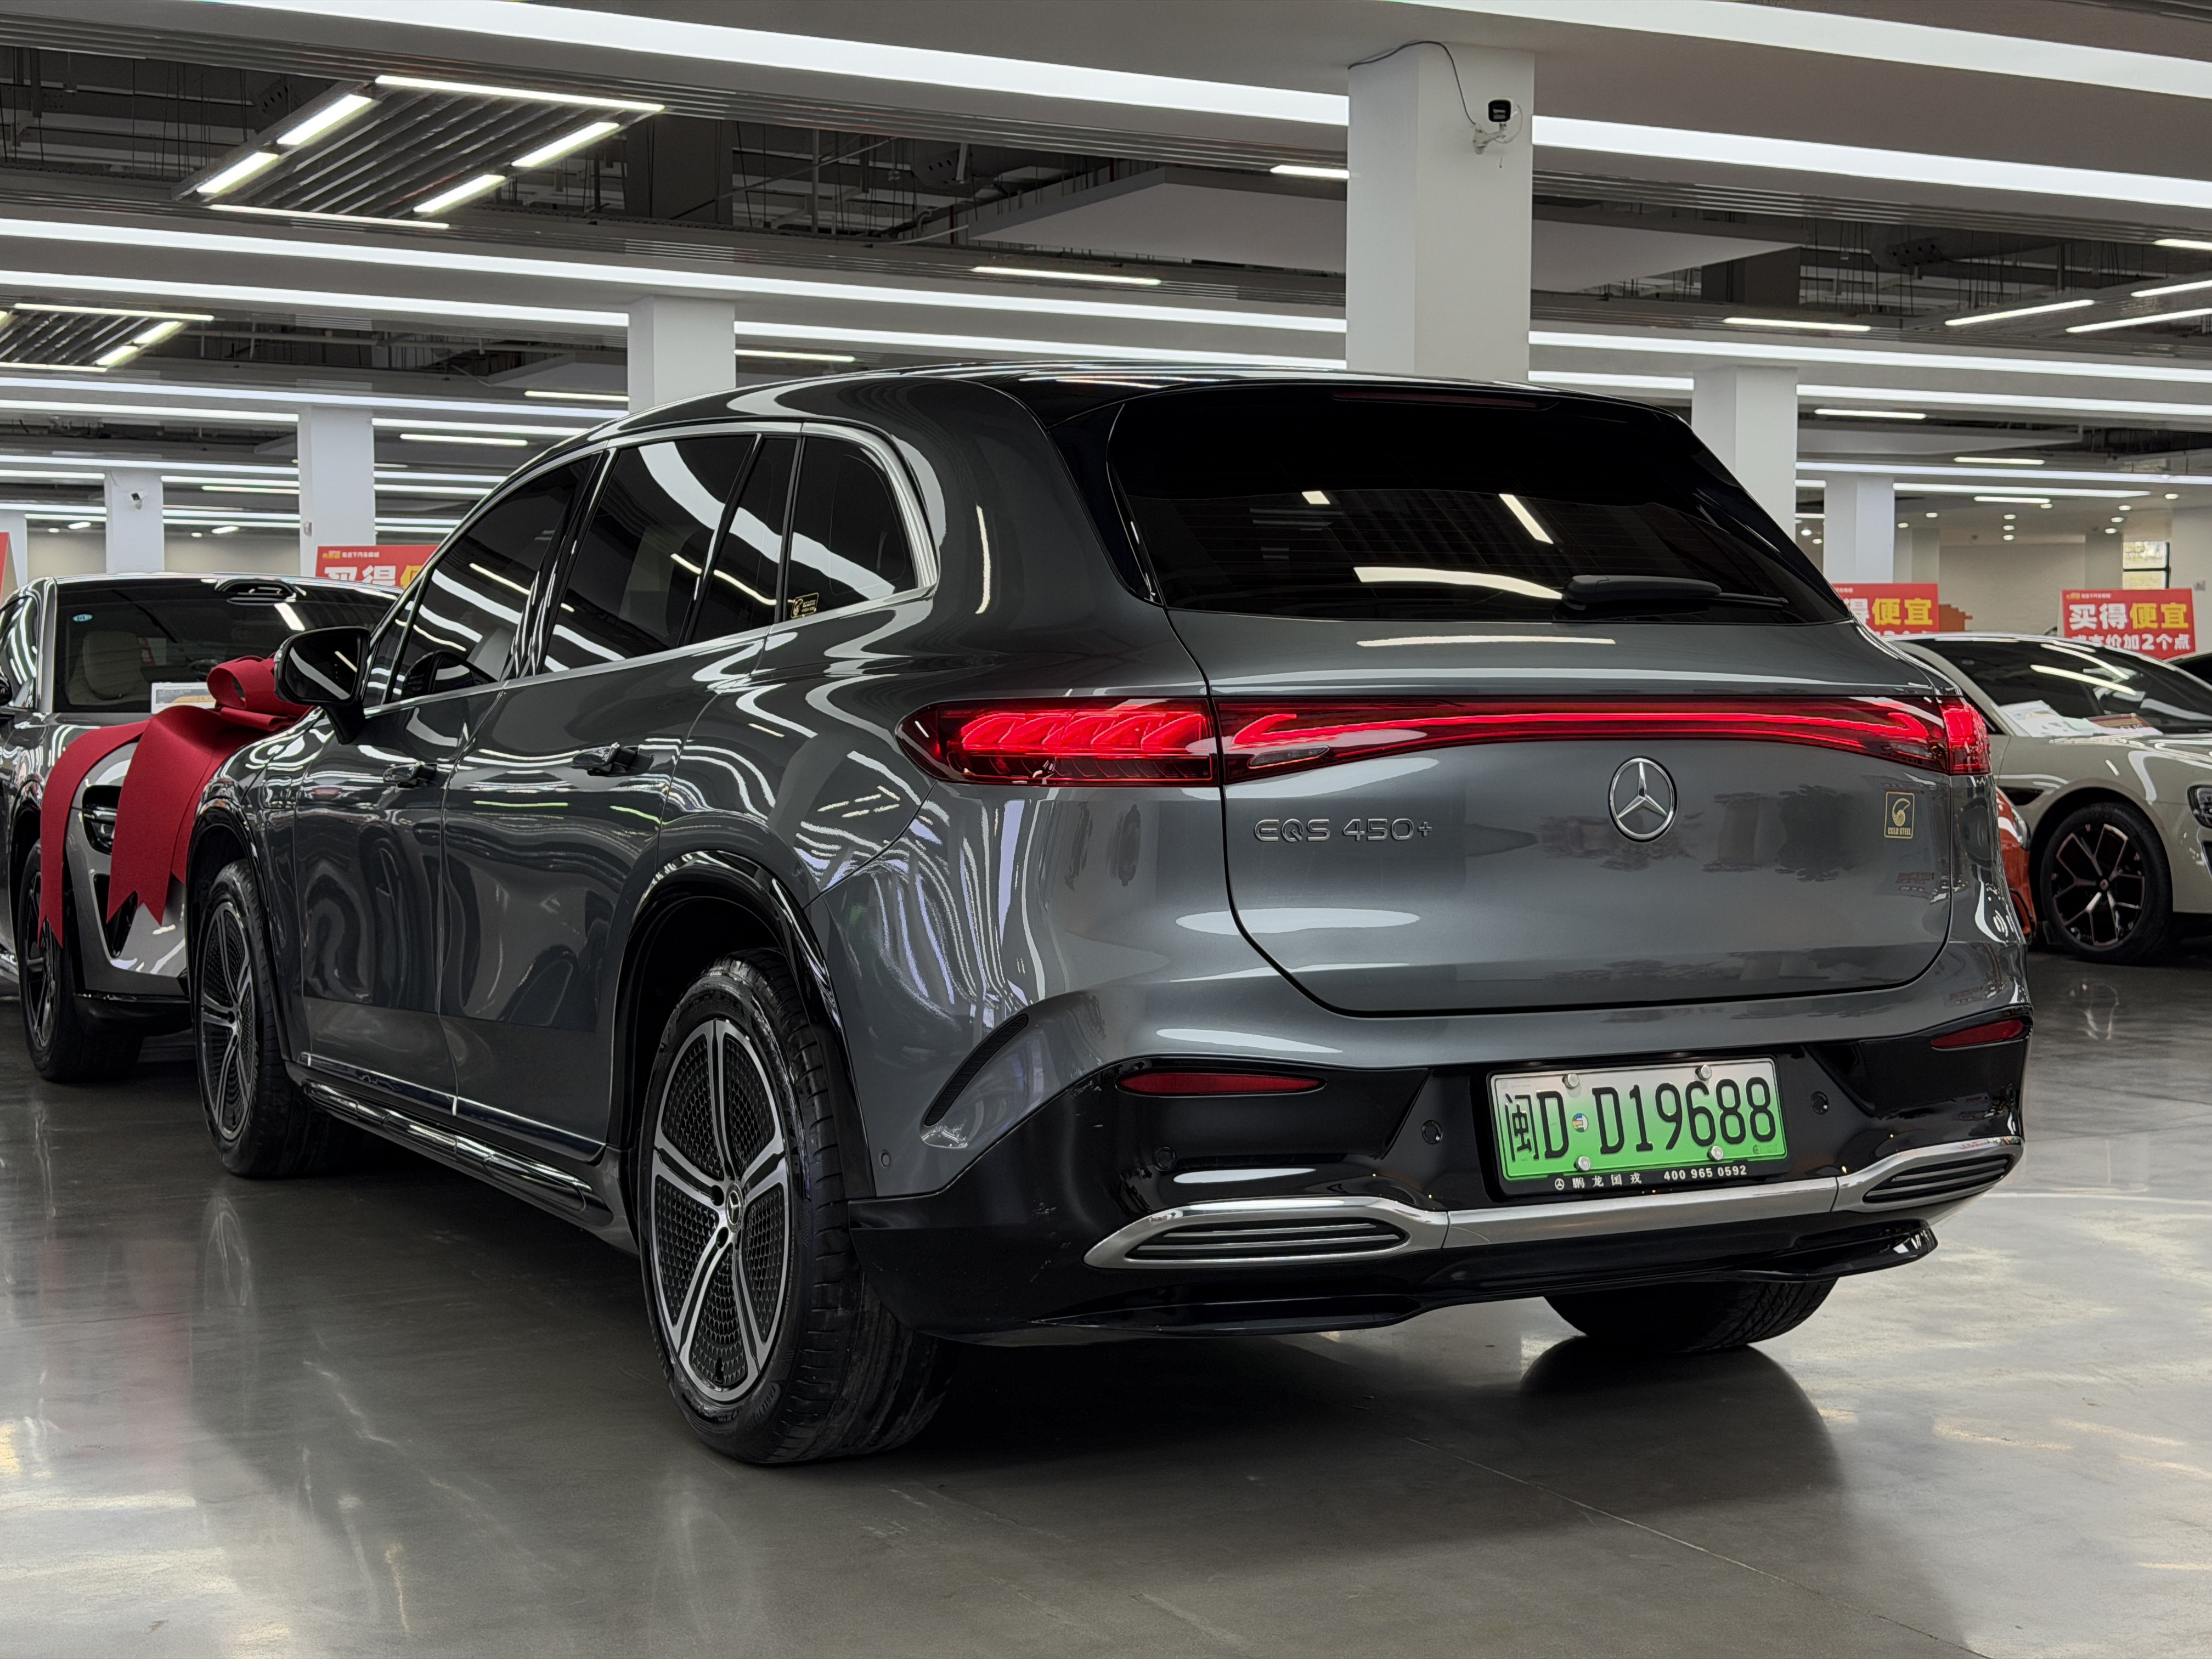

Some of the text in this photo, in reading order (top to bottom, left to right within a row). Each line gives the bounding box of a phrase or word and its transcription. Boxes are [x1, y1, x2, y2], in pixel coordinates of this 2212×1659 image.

[2069, 602, 2189, 630] 买得便宜
[1254, 818, 1432, 842] EQS 450+
[1504, 1076, 1776, 1162] 闽D D19688
[1572, 1165, 1747, 1189] 鹏龙国戎 400 965 0592
